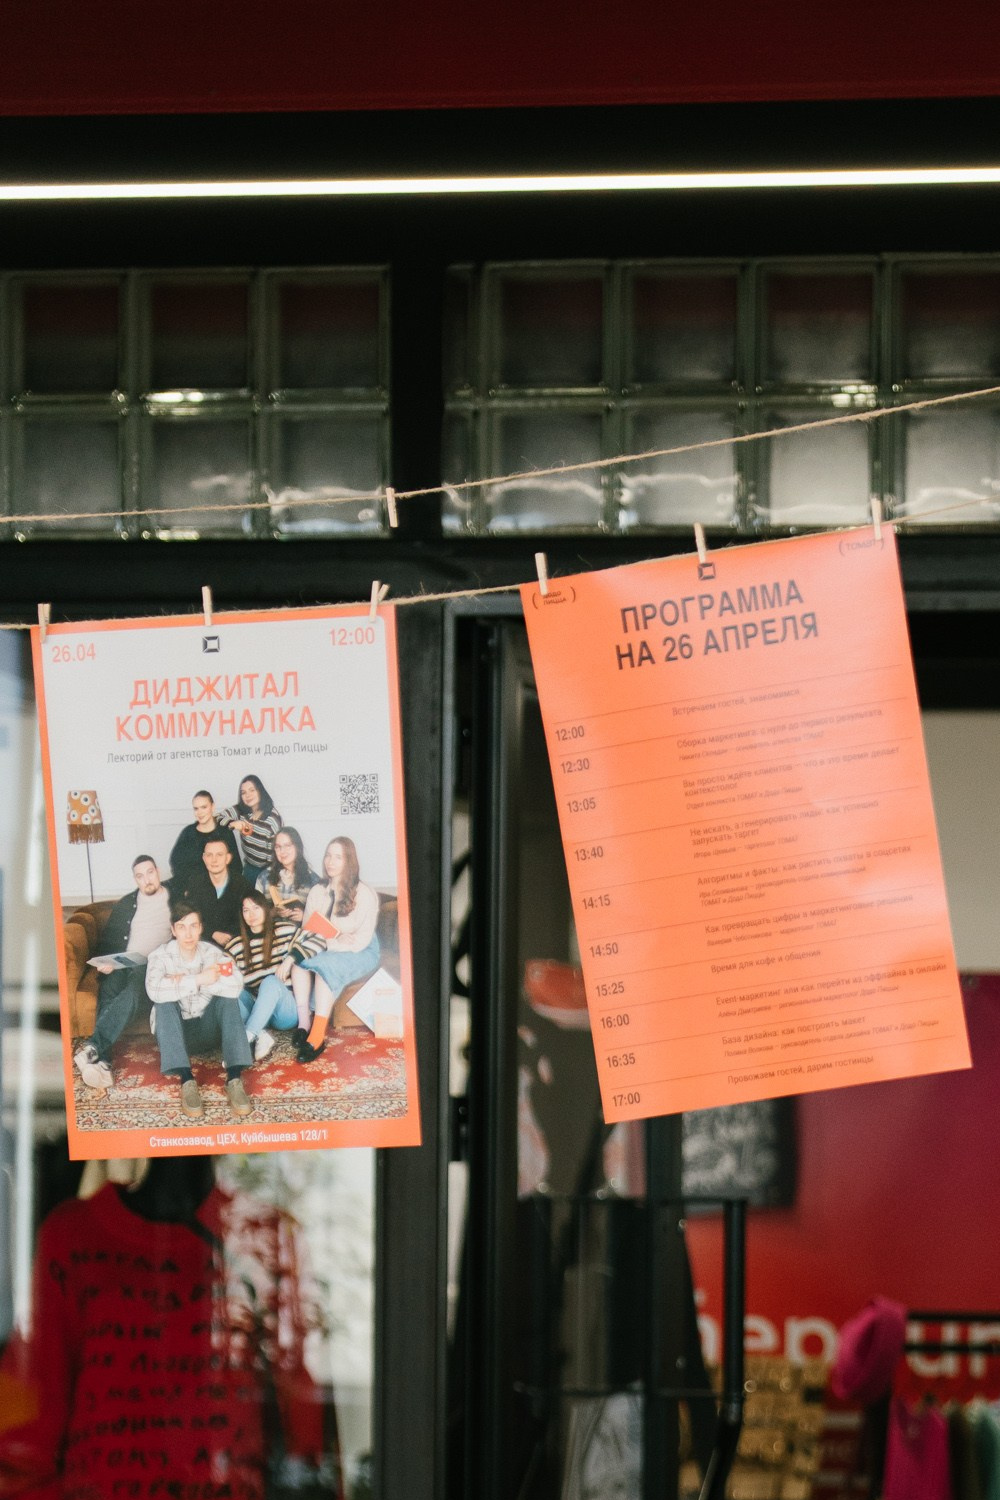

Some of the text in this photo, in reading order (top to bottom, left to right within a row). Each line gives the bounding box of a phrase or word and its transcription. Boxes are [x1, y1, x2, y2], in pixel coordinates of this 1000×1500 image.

[620, 580, 802, 633] ПРОГРАММА
[330, 627, 374, 645] 12:00
[616, 612, 817, 669] НА 26 АПРЕЛЯ
[53, 643, 95, 662] 26.04
[130, 671, 298, 708] ДИДЖИТАЛ
[116, 705, 315, 740] КОММУНАЛКА
[555, 725, 584, 740] 12:00
[106, 742, 327, 763] Лекторий от агентства Томат и Додо Пиццы
[561, 758, 589, 773] 12:30
[567, 797, 596, 812] 13:05
[575, 846, 603, 861] 13:40
[582, 894, 610, 909] 14:15
[590, 942, 618, 957] 14:50
[596, 981, 624, 996] 15:25
[601, 1013, 629, 1028] 16:00
[607, 1052, 635, 1067] 16:35
[613, 1092, 640, 1106] 17:00
[149, 1129, 327, 1148] Станкозавод, ЦЕХ, Куйбышева 128/1
